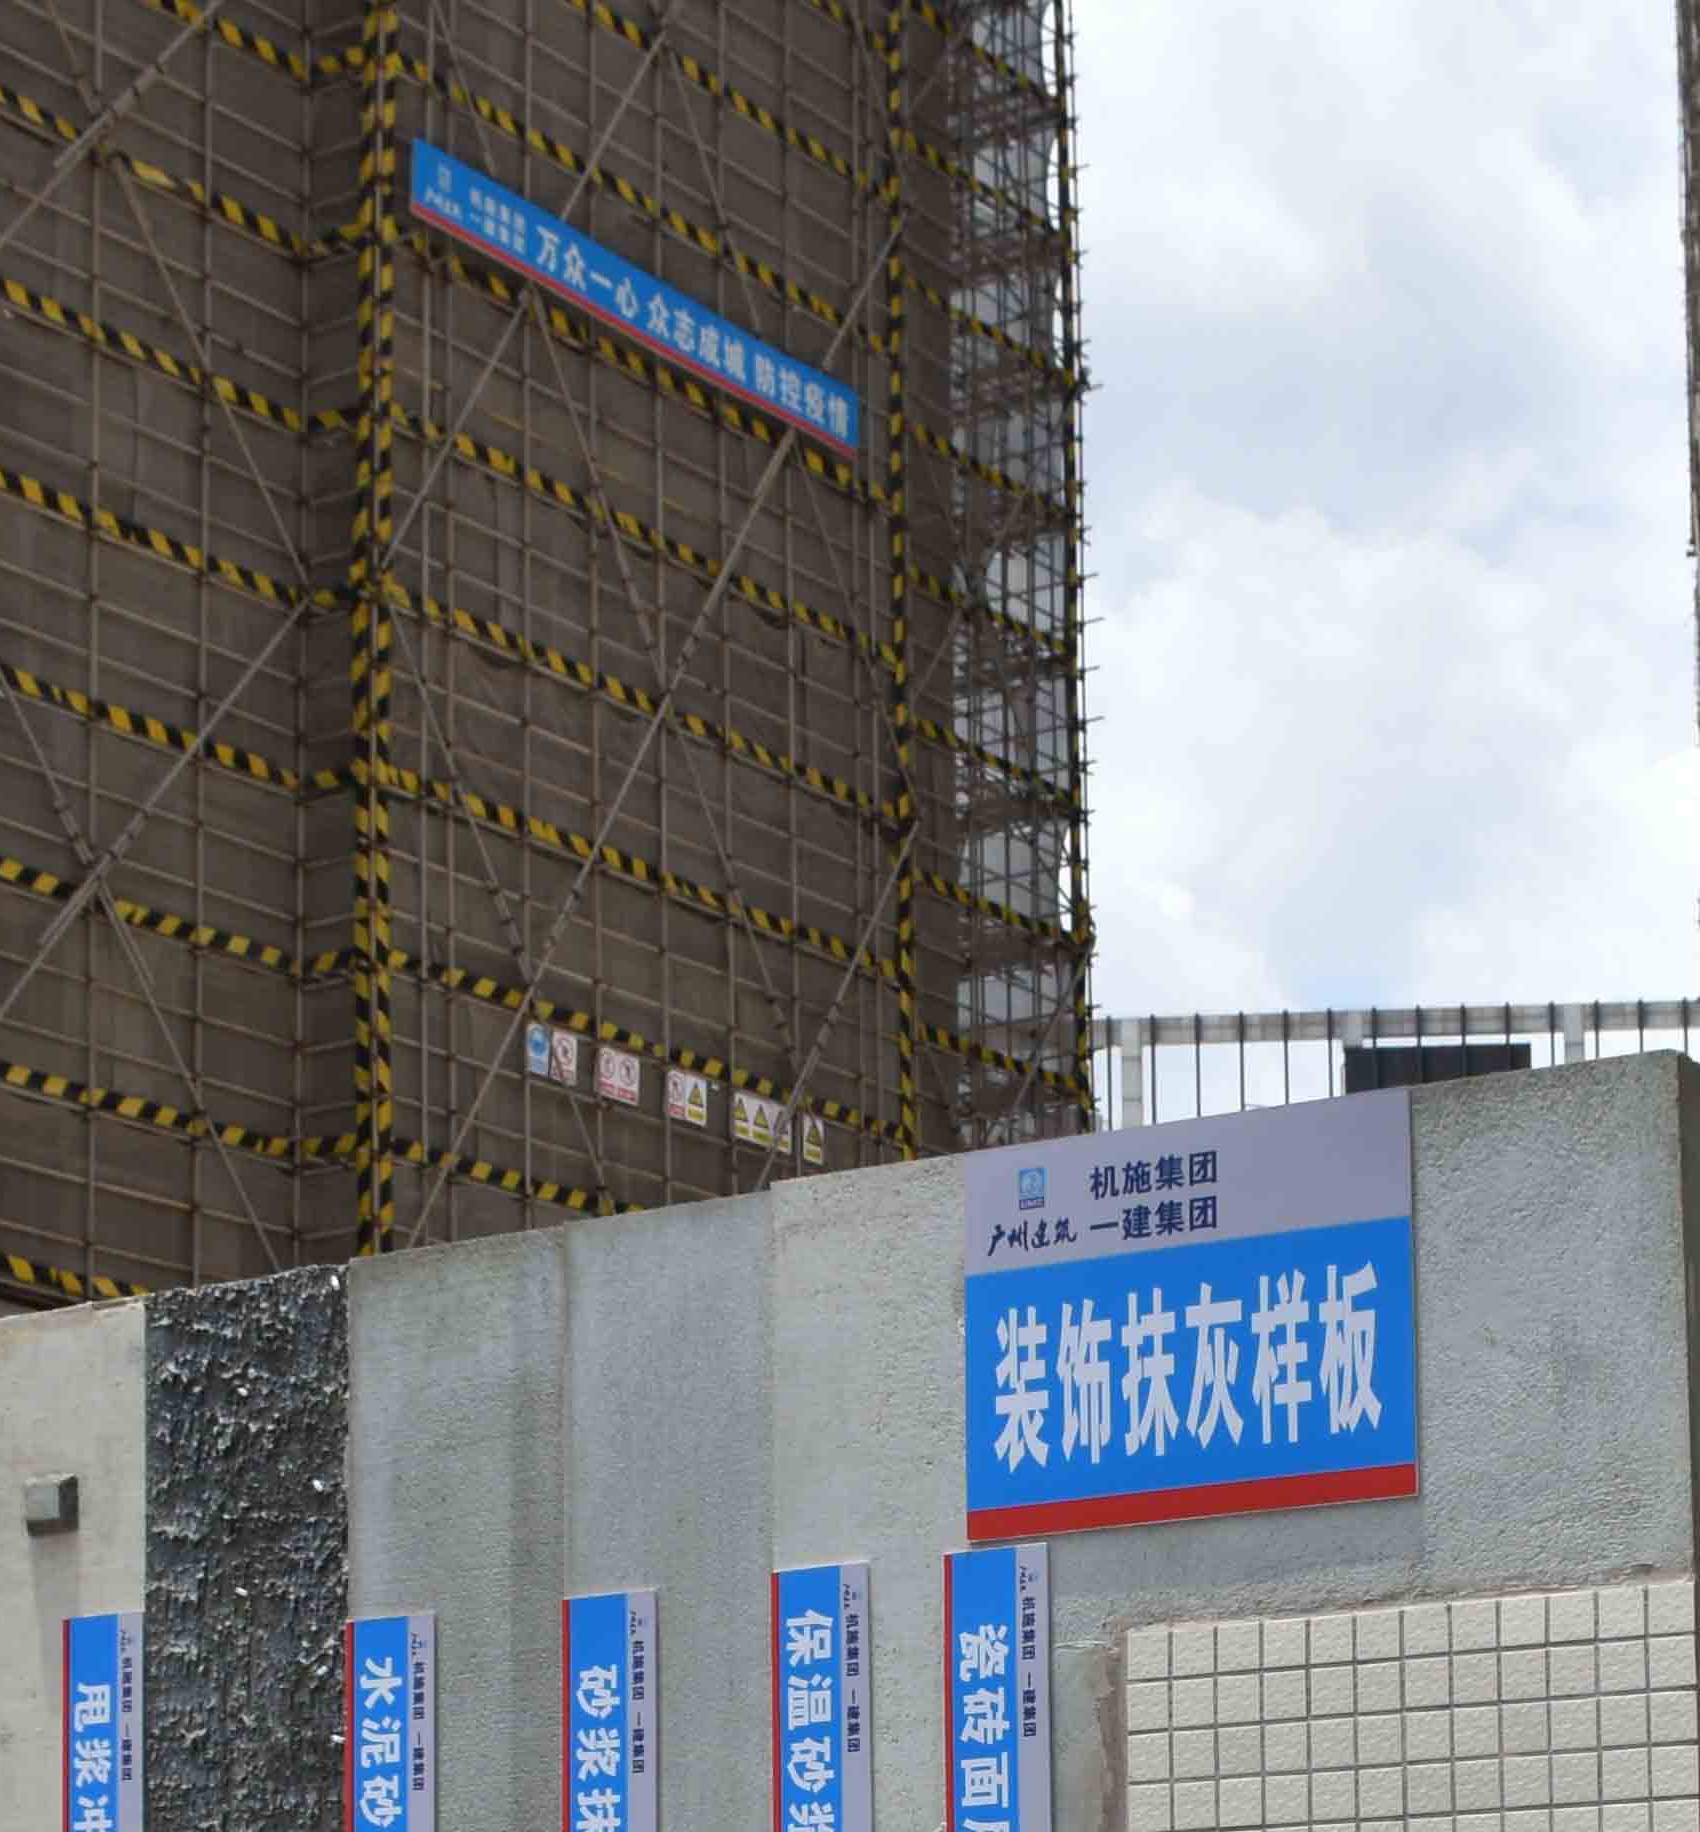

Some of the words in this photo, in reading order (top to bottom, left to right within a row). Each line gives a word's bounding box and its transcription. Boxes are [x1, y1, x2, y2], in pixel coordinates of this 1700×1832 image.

[535, 223, 639, 318] 万众一心
[645, 292, 749, 383] 众志成城
[753, 353, 851, 439] 防控疫情
[1088, 1150, 1218, 1200] 机施集团
[986, 1217, 1078, 1257] 广州建筑
[1089, 1195, 1218, 1241] 一建集团
[993, 1259, 1383, 1474] 装饰抹灰样板
[845, 1613, 860, 1677] 机施集团
[1021, 1597, 1036, 1661] 机施集团
[631, 1640, 645, 1701] 机施集团
[846, 1688, 861, 1753] 一建集团
[1022, 1671, 1037, 1738] 一建集团
[631, 1711, 645, 1774] 一建集团
